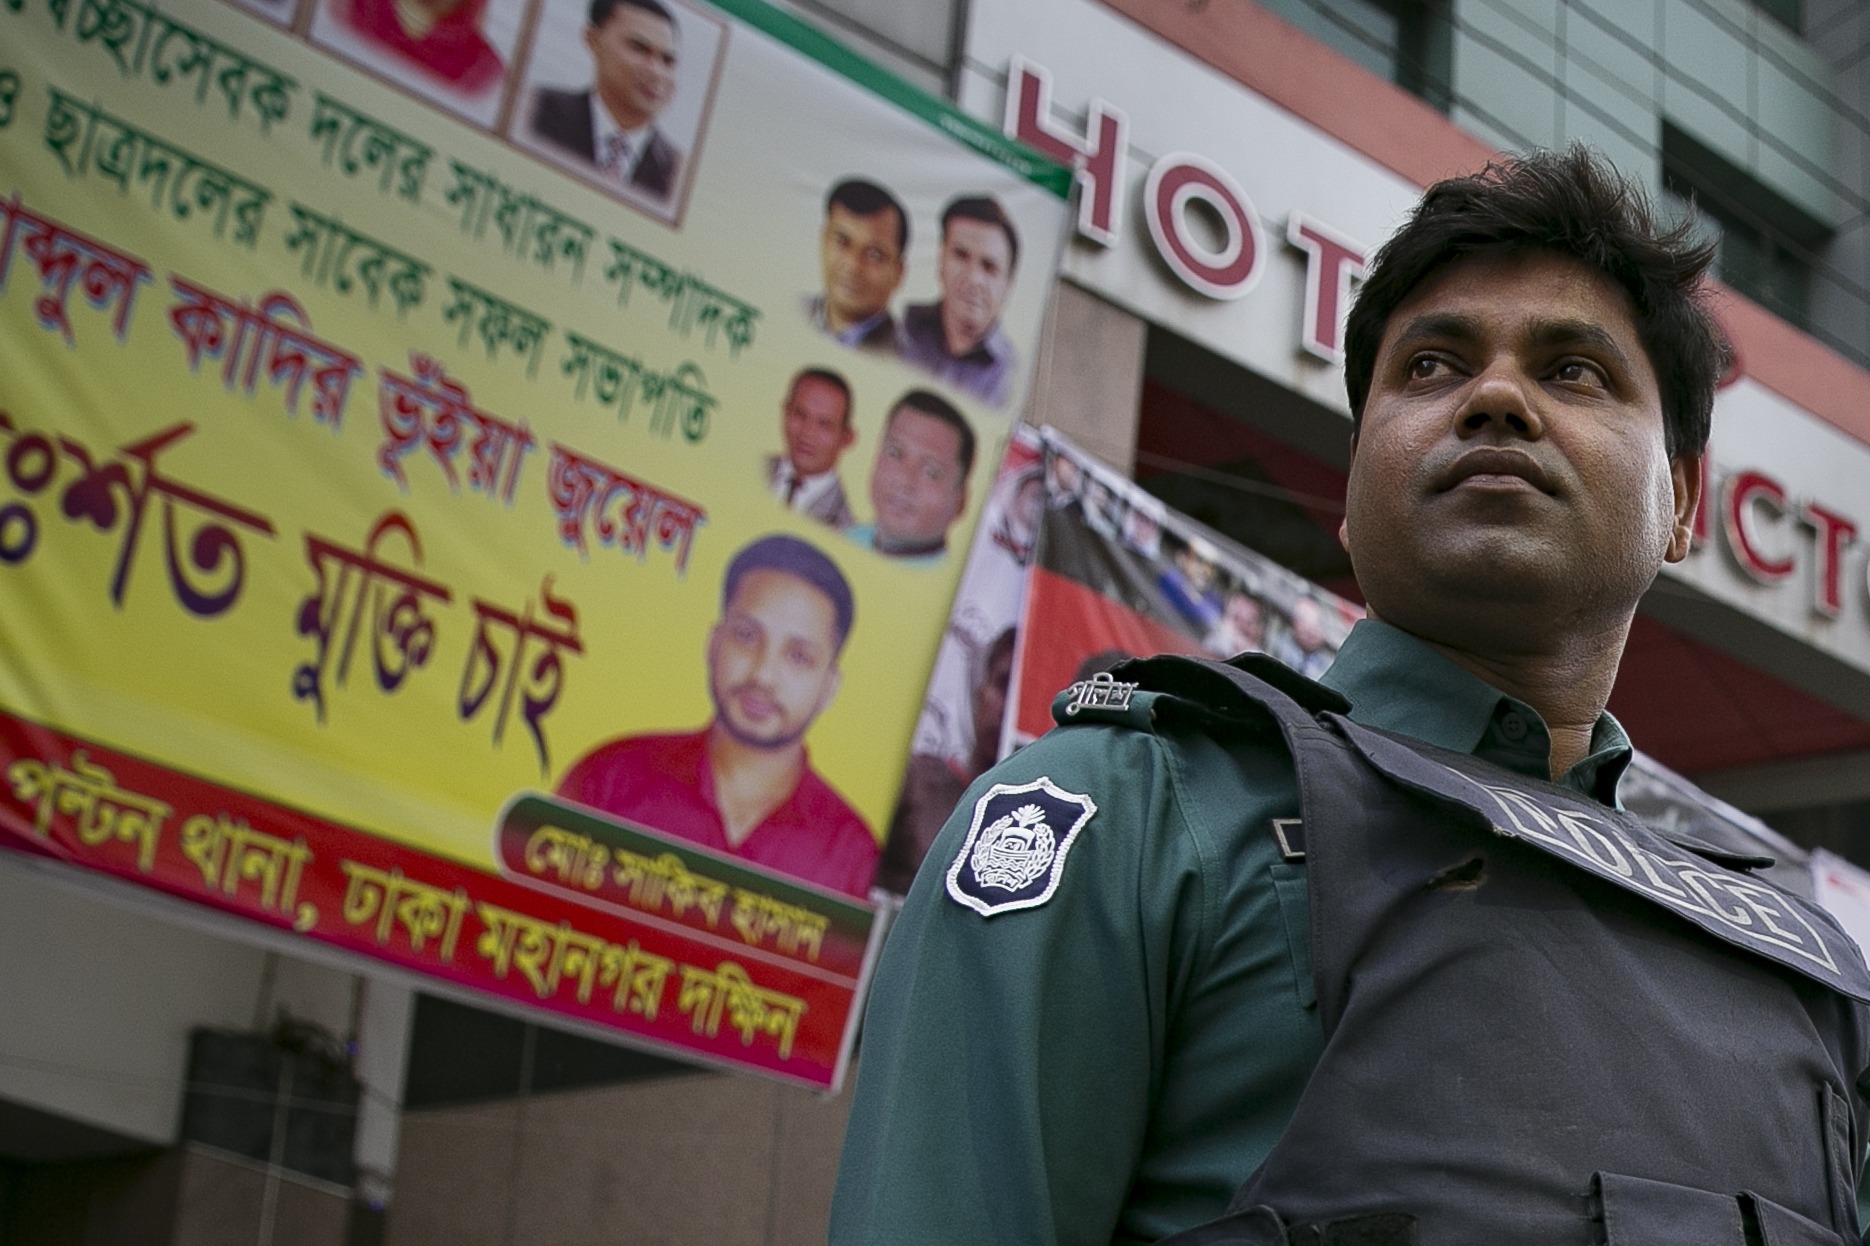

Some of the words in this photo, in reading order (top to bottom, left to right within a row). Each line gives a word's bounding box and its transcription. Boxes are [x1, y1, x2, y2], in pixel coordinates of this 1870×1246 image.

[308, 88, 436, 207] দলের
[168, 272, 366, 434] কাদির
[286, 200, 434, 322] সাবেক
[560, 328, 721, 444] সভাপতি
[292, 508, 454, 728] মুক্তি
[460, 572, 586, 782] চাই
[180, 812, 319, 932] থানা,
[341, 858, 474, 965] ঢাকা
[475, 898, 674, 1022] মহানগর
